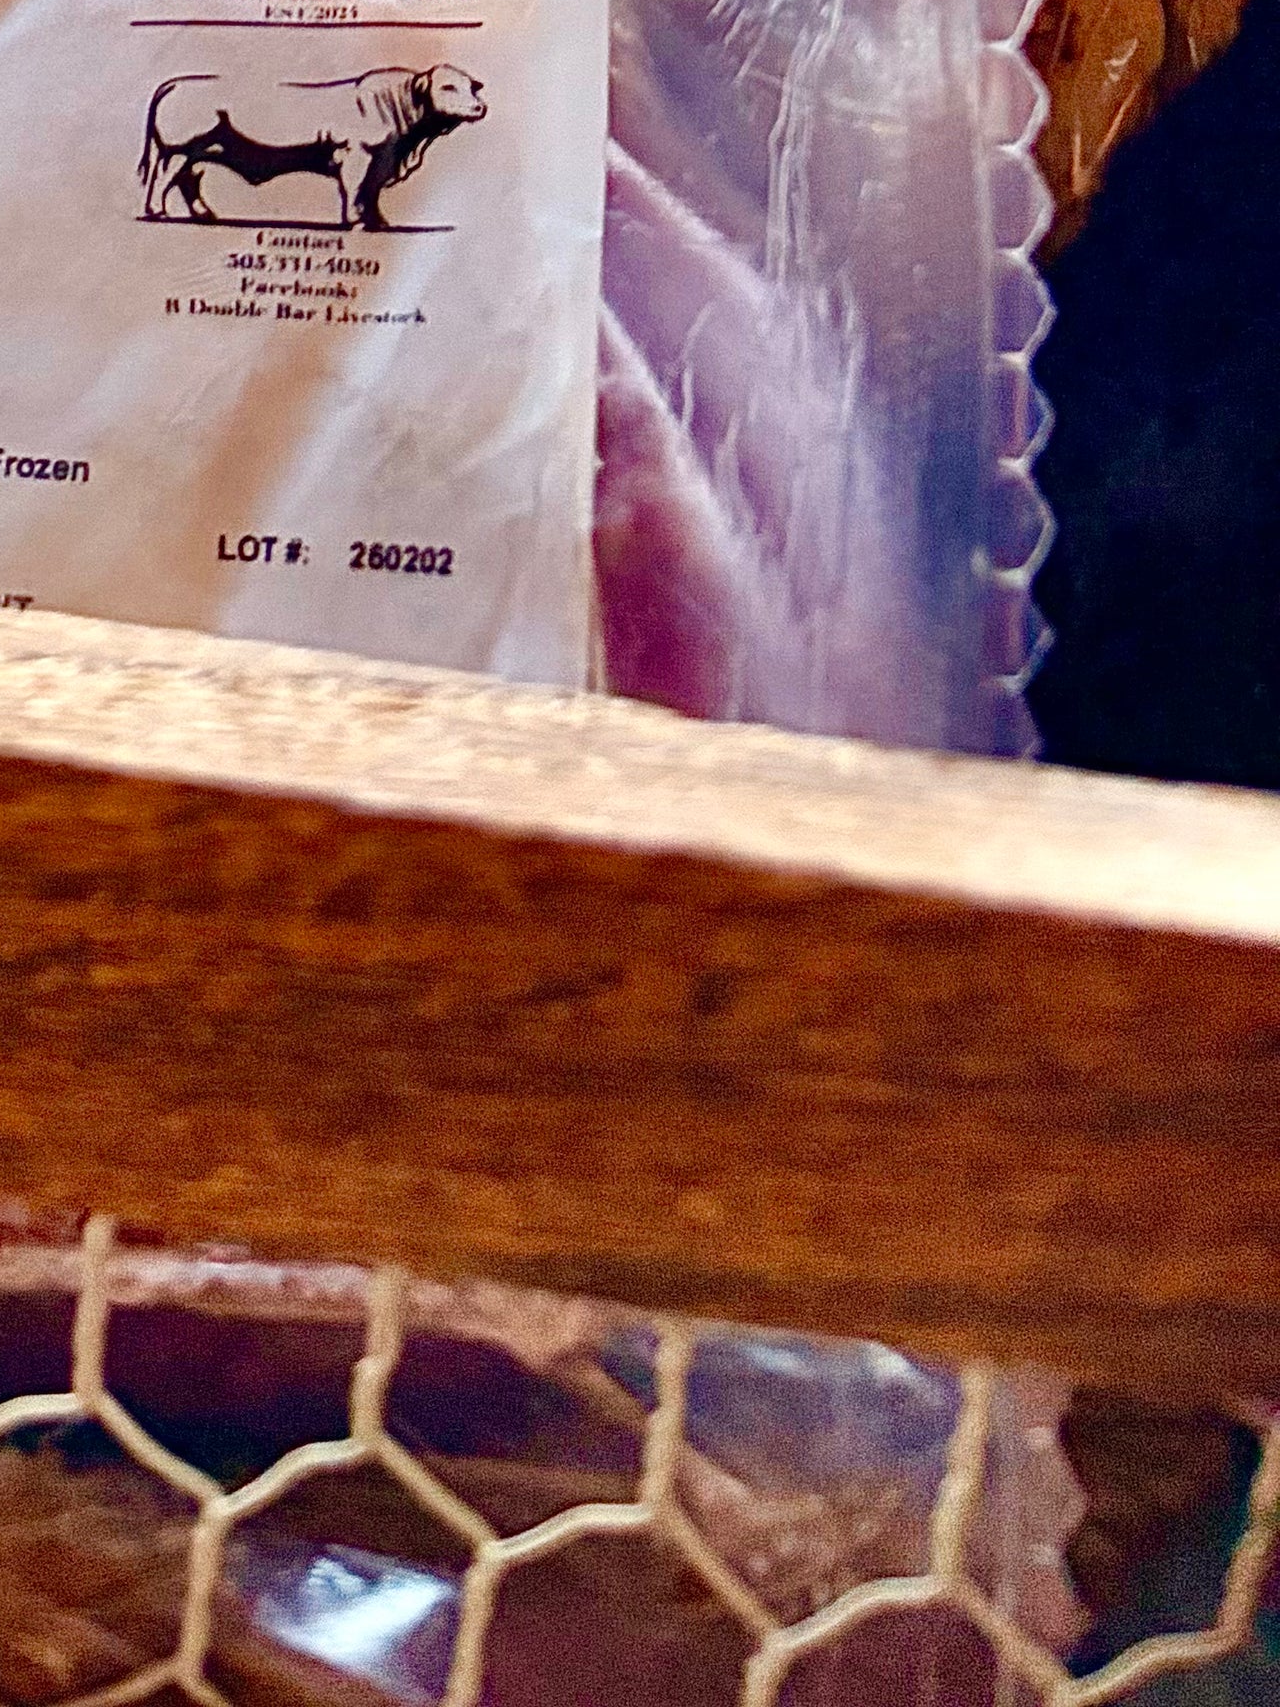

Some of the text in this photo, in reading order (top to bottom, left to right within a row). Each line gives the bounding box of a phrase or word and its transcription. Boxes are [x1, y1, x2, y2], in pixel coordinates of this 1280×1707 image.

[189, 298, 266, 318] Double
[276, 303, 317, 321] Bar
[217, 532, 278, 563] LOT
[349, 541, 453, 576] 260202
